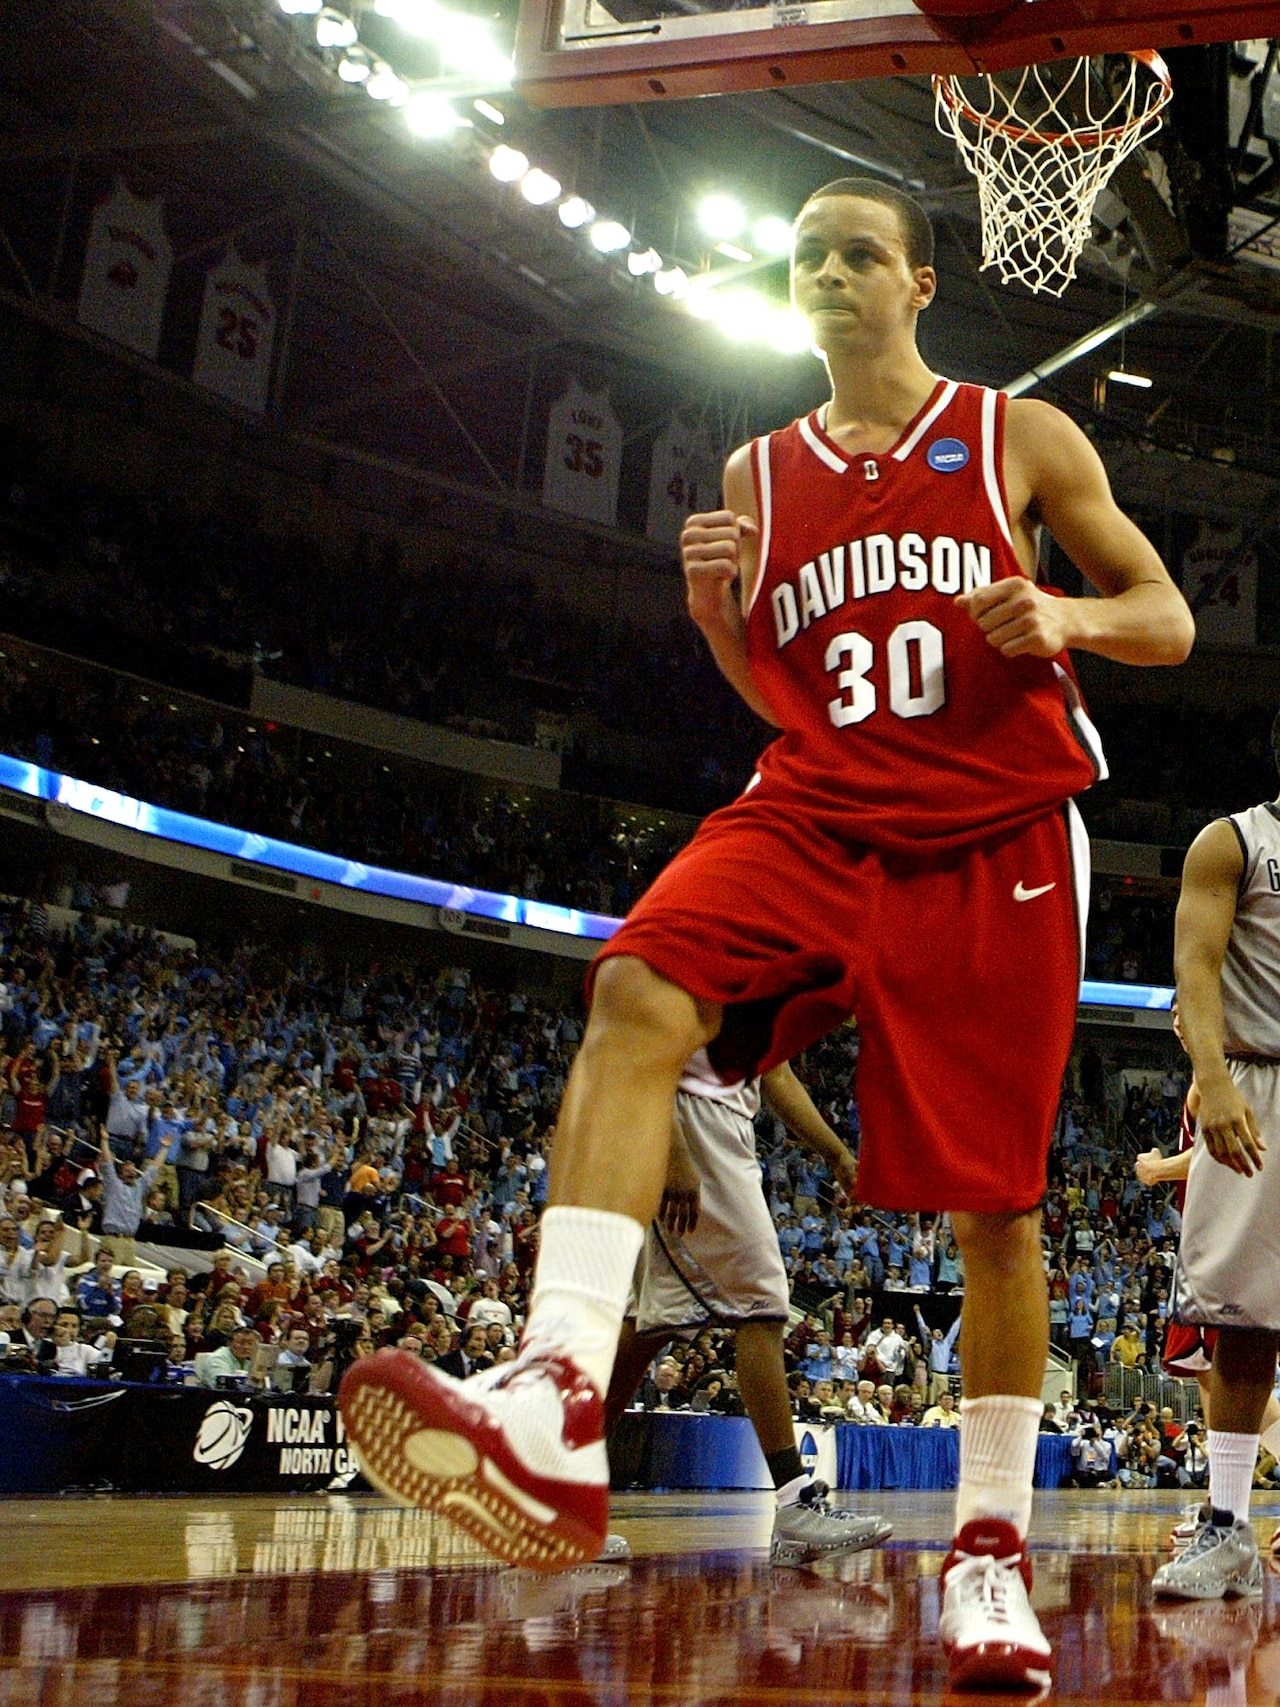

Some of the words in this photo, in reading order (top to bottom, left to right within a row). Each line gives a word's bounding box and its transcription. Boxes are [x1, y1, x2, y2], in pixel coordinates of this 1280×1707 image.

[217, 307, 256, 359] 25
[564, 434, 603, 478] 35
[771, 532, 991, 649] DAVIDSON
[824, 619, 945, 728] 30
[279, 1447, 333, 1475] NORTH
